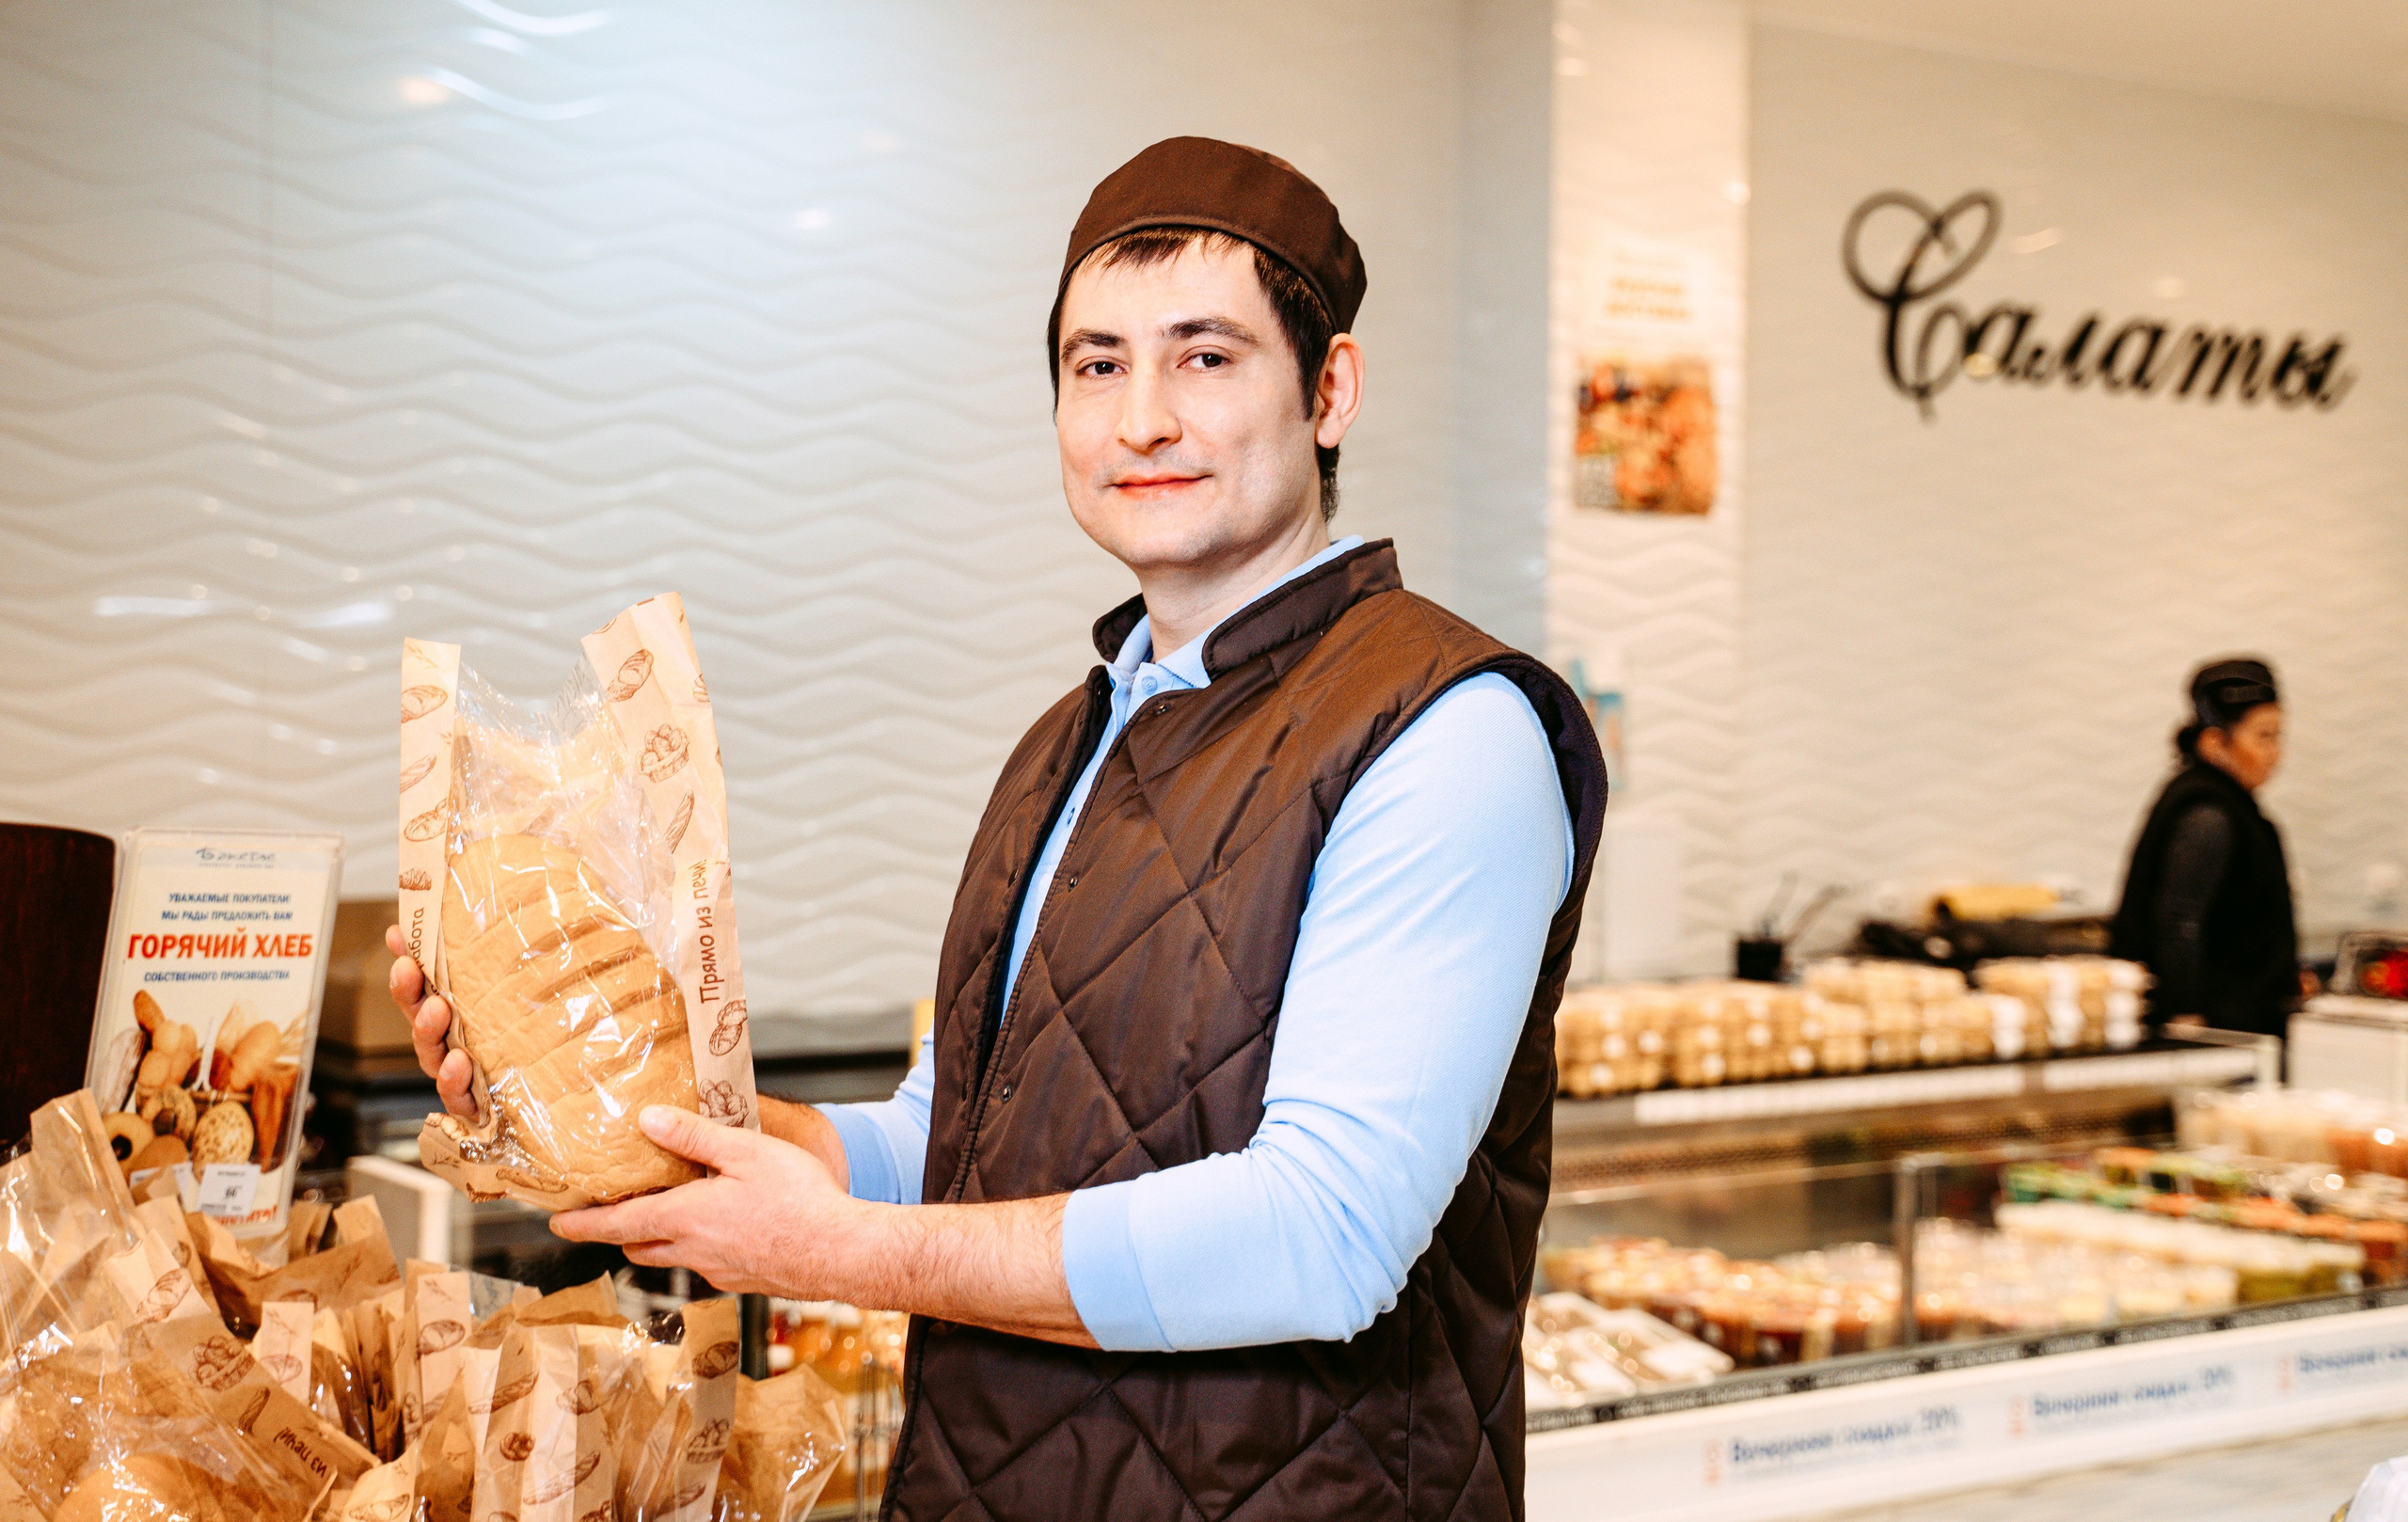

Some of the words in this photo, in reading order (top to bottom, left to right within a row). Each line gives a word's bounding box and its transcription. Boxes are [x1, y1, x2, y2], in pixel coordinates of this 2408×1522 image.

[1840, 187, 2358, 425] Салаты
[689, 859, 708, 899] печи!
[168, 893, 230, 904] УВАЖАЕМЫЕ
[161, 911, 179, 920] МЫ
[182, 911, 209, 922] РАДЫ
[211, 911, 271, 922] ПРЕДЛОЖИТЬ
[273, 911, 293, 921] ВАМ
[696, 906, 713, 928] из
[127, 926, 248, 959] ГОРЯЧИЙ
[252, 932, 313, 959] ХЛЕБ
[144, 971, 217, 982] СОБСТВЕННОГО
[219, 970, 290, 981] ПРОИЗВОДСТВА
[699, 935, 724, 1004] Прямо
[310, 1456, 327, 1478] из
